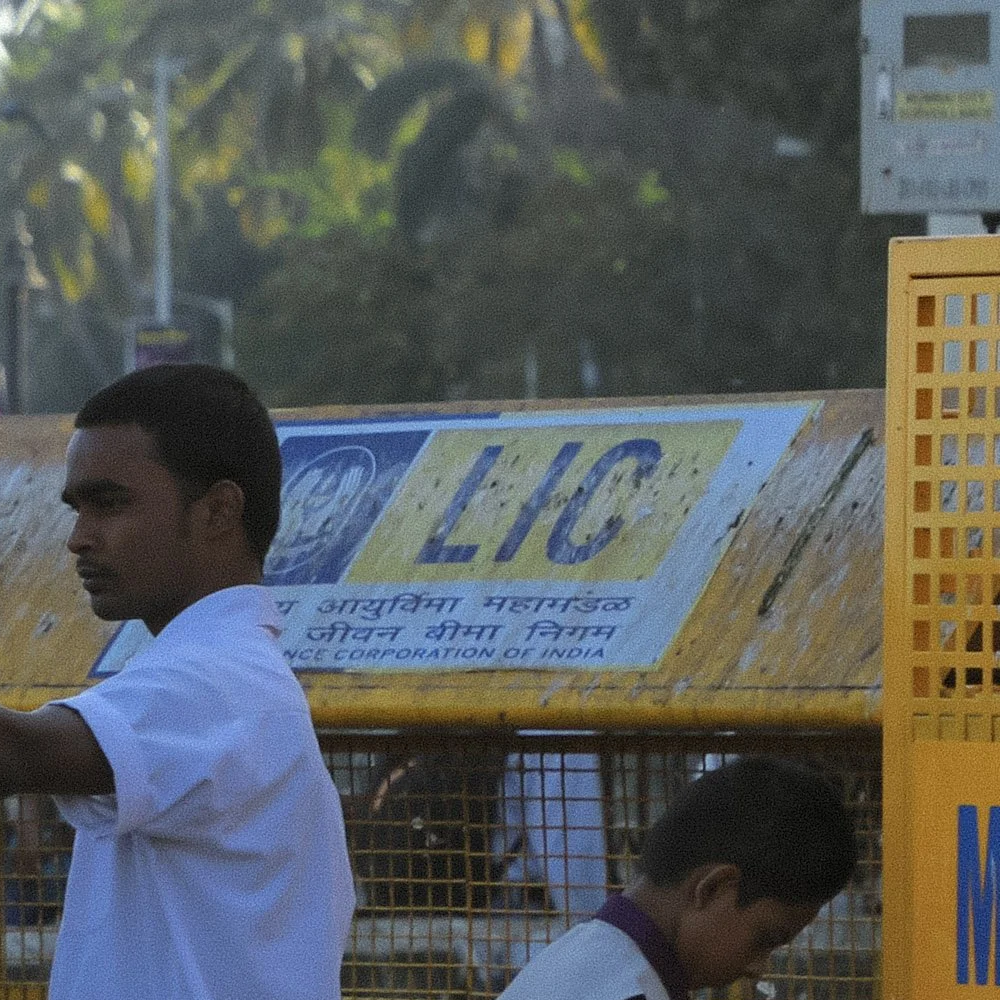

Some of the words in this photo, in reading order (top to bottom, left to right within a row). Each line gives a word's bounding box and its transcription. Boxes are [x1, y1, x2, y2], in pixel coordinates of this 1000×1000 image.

[415, 439, 661, 565] LIC
[484, 590, 635, 614] महामंडळ
[307, 621, 405, 643] जीवन
[425, 619, 503, 641] बीमा
[524, 619, 618, 642] निगम
[334, 647, 496, 661] CORPORATION
[503, 647, 534, 659] OF
[541, 647, 605, 660] INDIA
